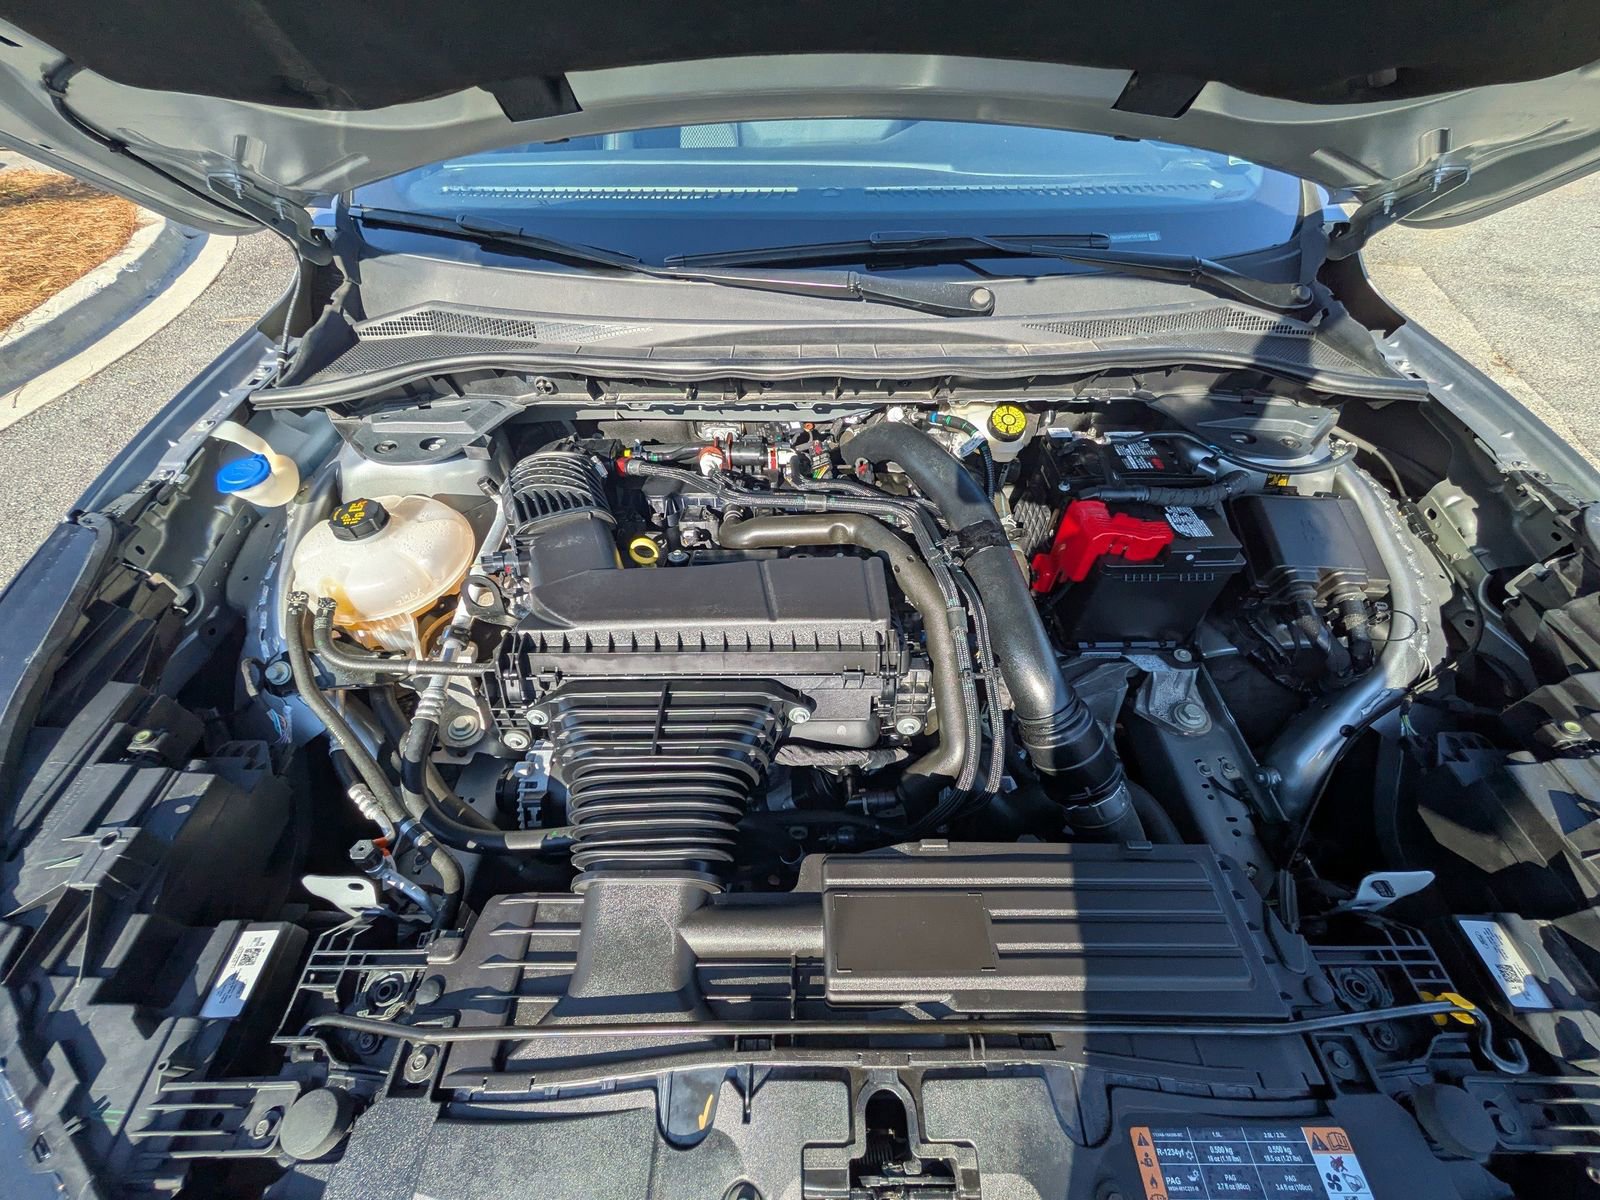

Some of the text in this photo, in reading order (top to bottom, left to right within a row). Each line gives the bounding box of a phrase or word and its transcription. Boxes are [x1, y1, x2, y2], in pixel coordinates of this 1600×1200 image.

[1156, 1148, 1185, 1158] R-1234yf
[1209, 1145, 1234, 1156] 0.500 kg
[1283, 1145, 1293, 1155] kg
[1165, 1176, 1182, 1185] PAG
[1224, 1174, 1237, 1182] PAG
[1284, 1174, 1297, 1182] PAG
